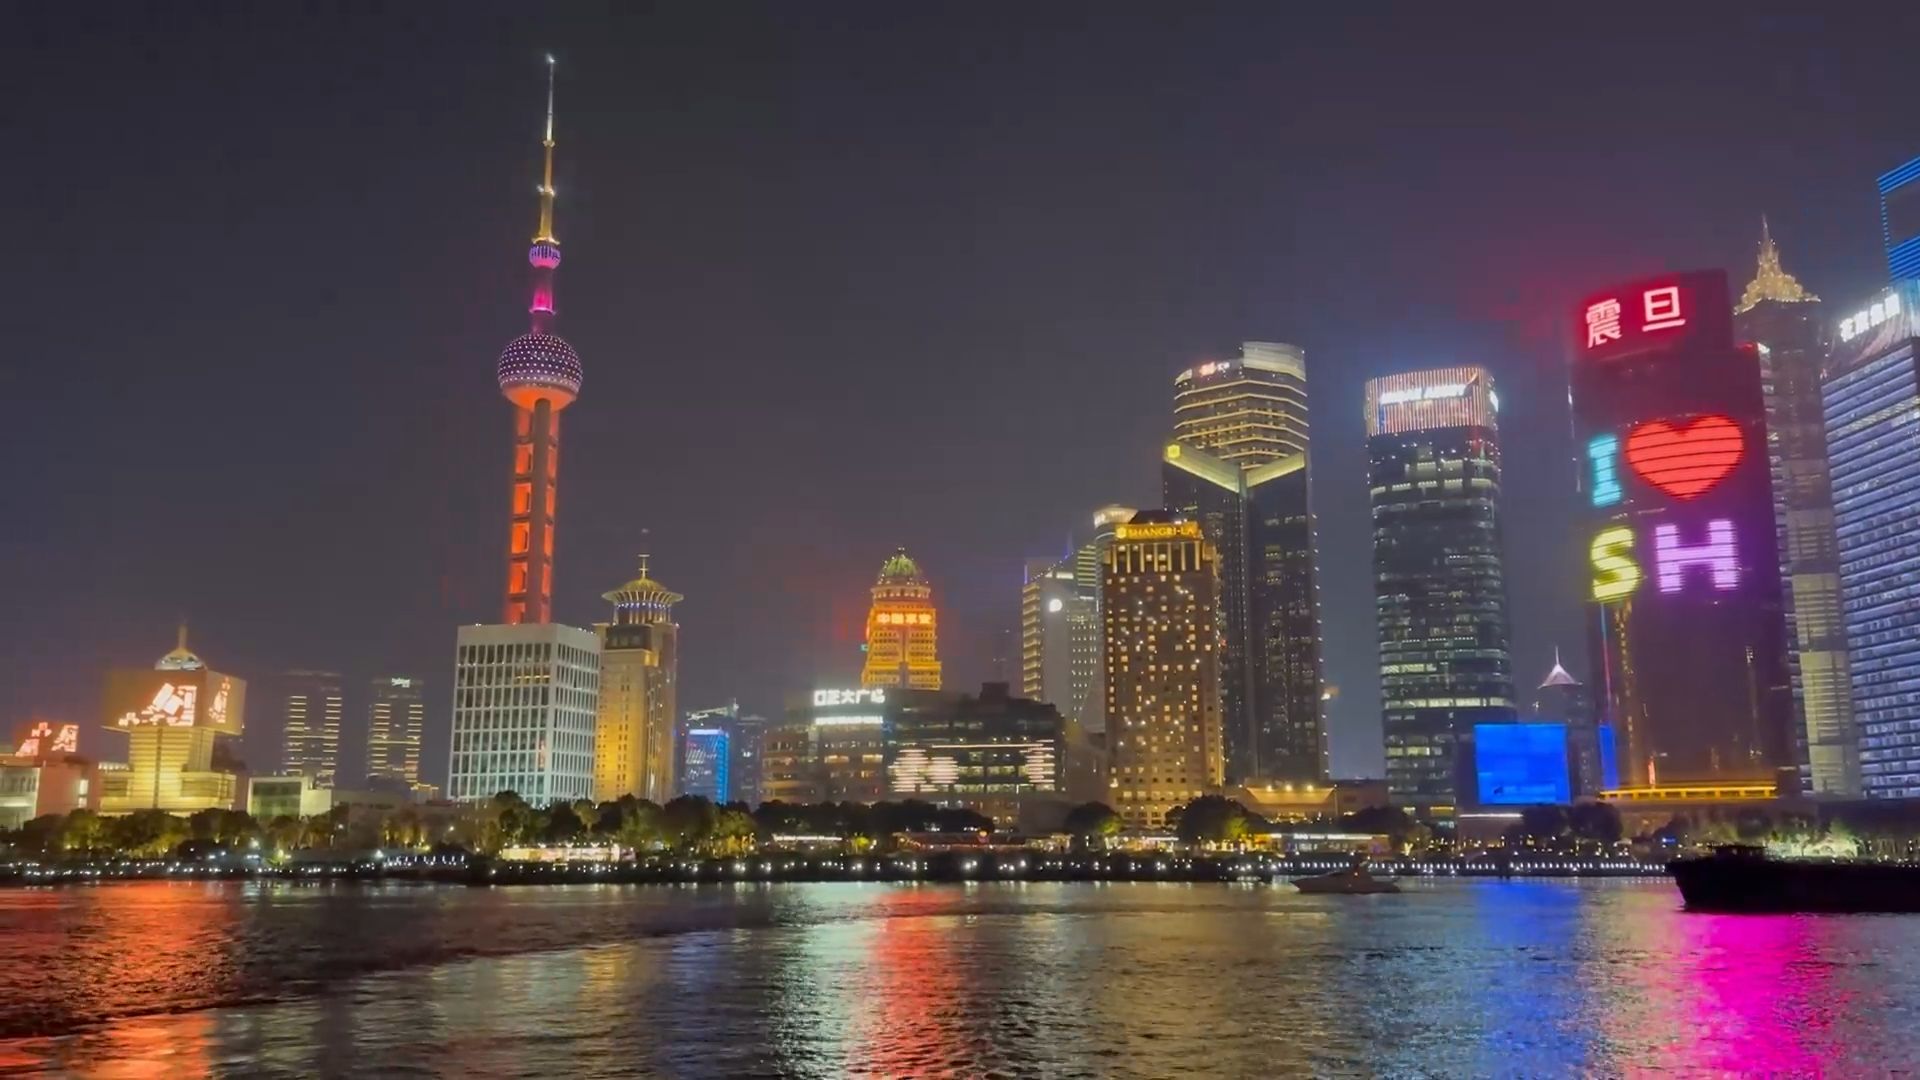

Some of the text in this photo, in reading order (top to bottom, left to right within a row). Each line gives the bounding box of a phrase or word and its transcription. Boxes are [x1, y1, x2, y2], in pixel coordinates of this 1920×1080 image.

[1586, 286, 1686, 349] 震旦
[1588, 433, 1622, 506] I
[1127, 526, 1196, 538] SHANGRI-LA
